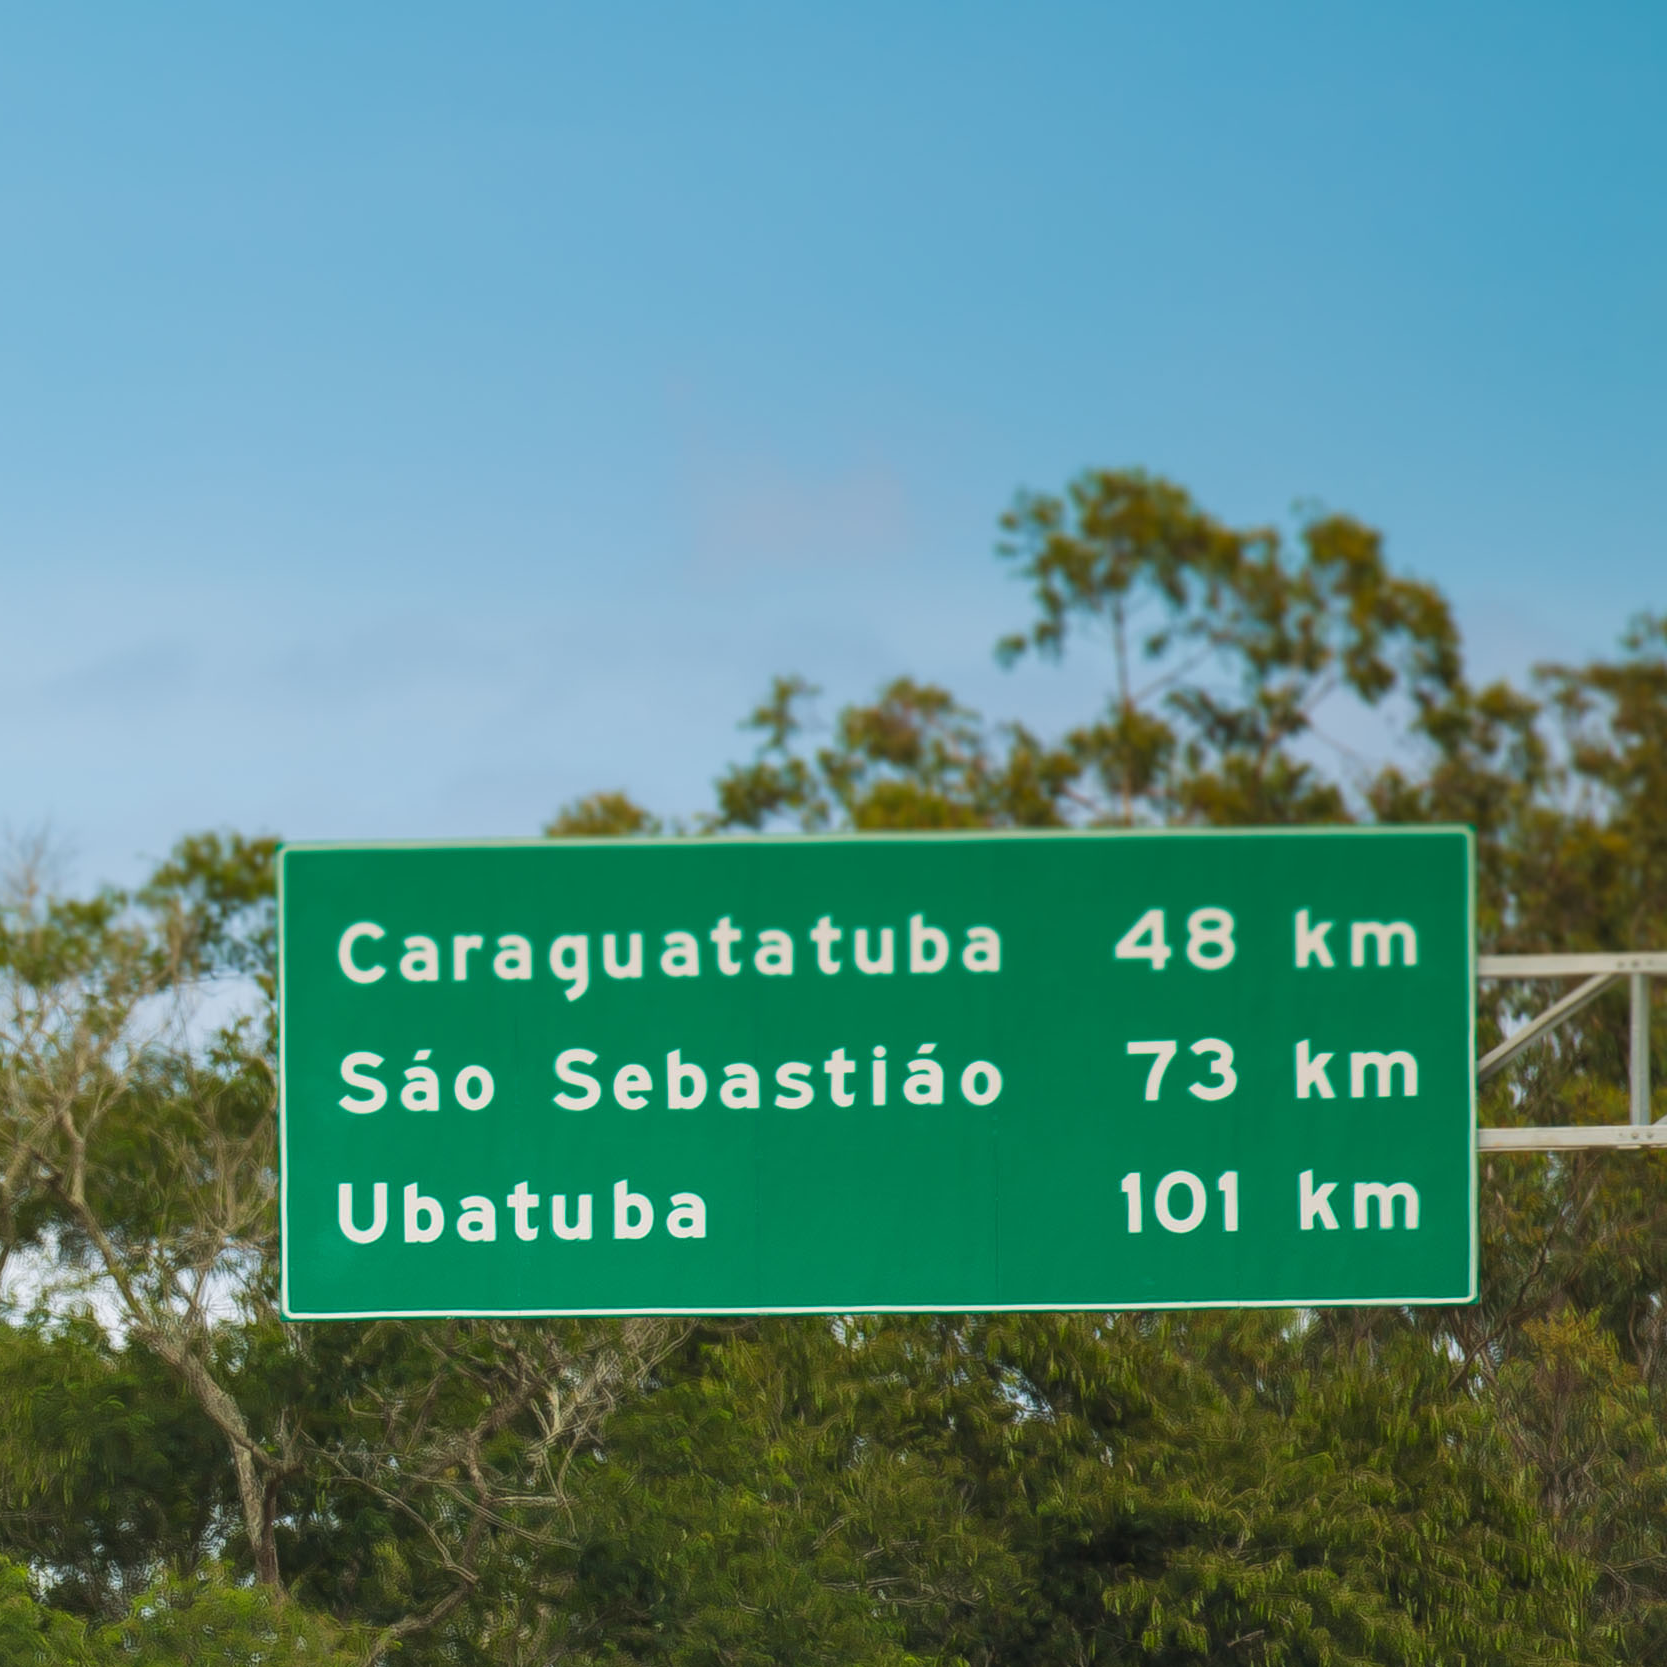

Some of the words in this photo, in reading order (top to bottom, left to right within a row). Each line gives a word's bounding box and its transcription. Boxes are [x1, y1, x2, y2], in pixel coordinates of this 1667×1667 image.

[338, 914, 1002, 1002] Caraguatatuba
[1115, 907, 1237, 971] 48
[1295, 909, 1417, 968] km
[1126, 1038, 1239, 1102] 73
[1295, 1039, 1418, 1099] km
[338, 1179, 708, 1245] Ubatuba
[1121, 1170, 1239, 1234] 101
[1299, 1169, 1419, 1231] km
